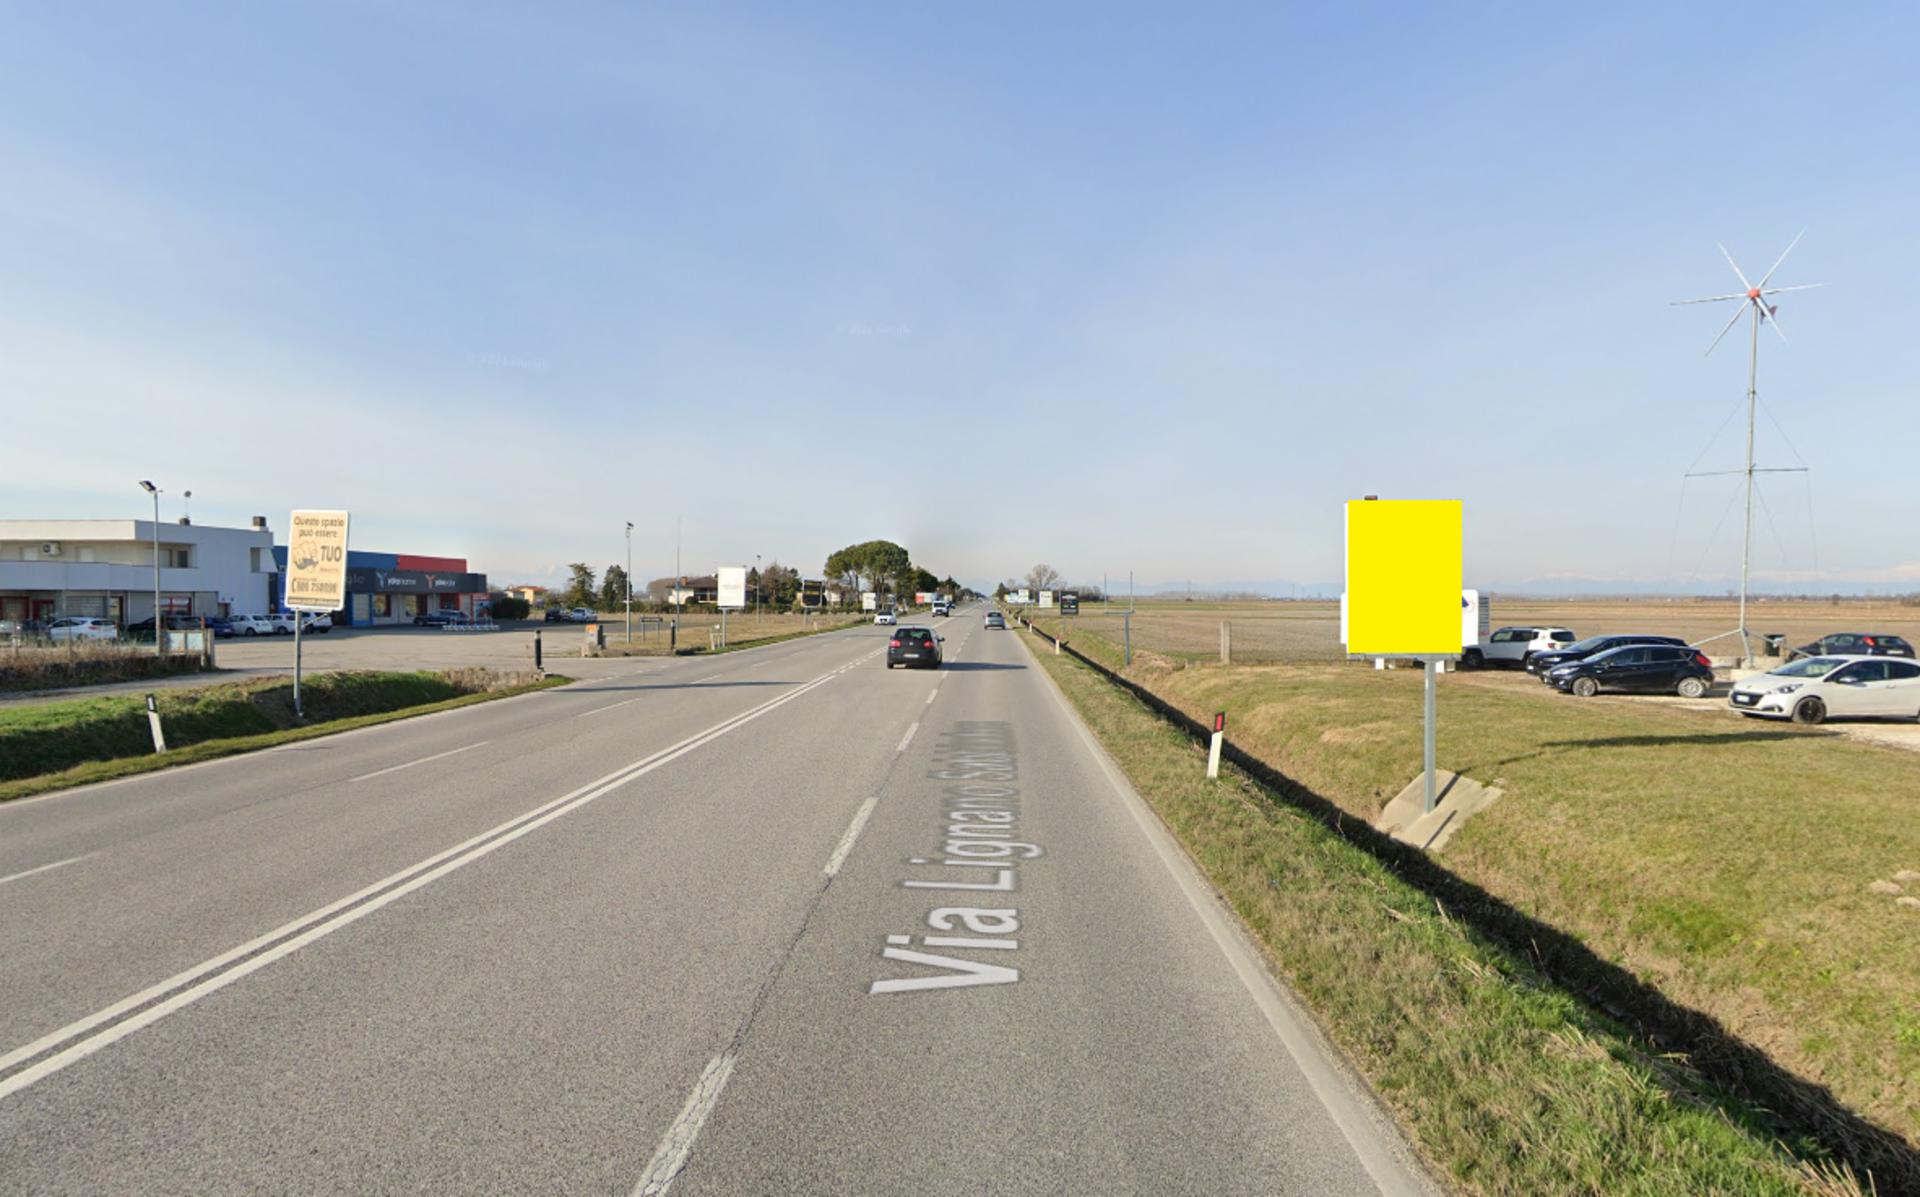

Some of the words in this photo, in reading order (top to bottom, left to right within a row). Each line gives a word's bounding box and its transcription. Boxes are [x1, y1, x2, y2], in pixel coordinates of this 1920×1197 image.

[293, 516, 319, 526] Questo
[321, 519, 345, 528] spazio
[315, 530, 337, 538] essere
[321, 545, 342, 562] TUO
